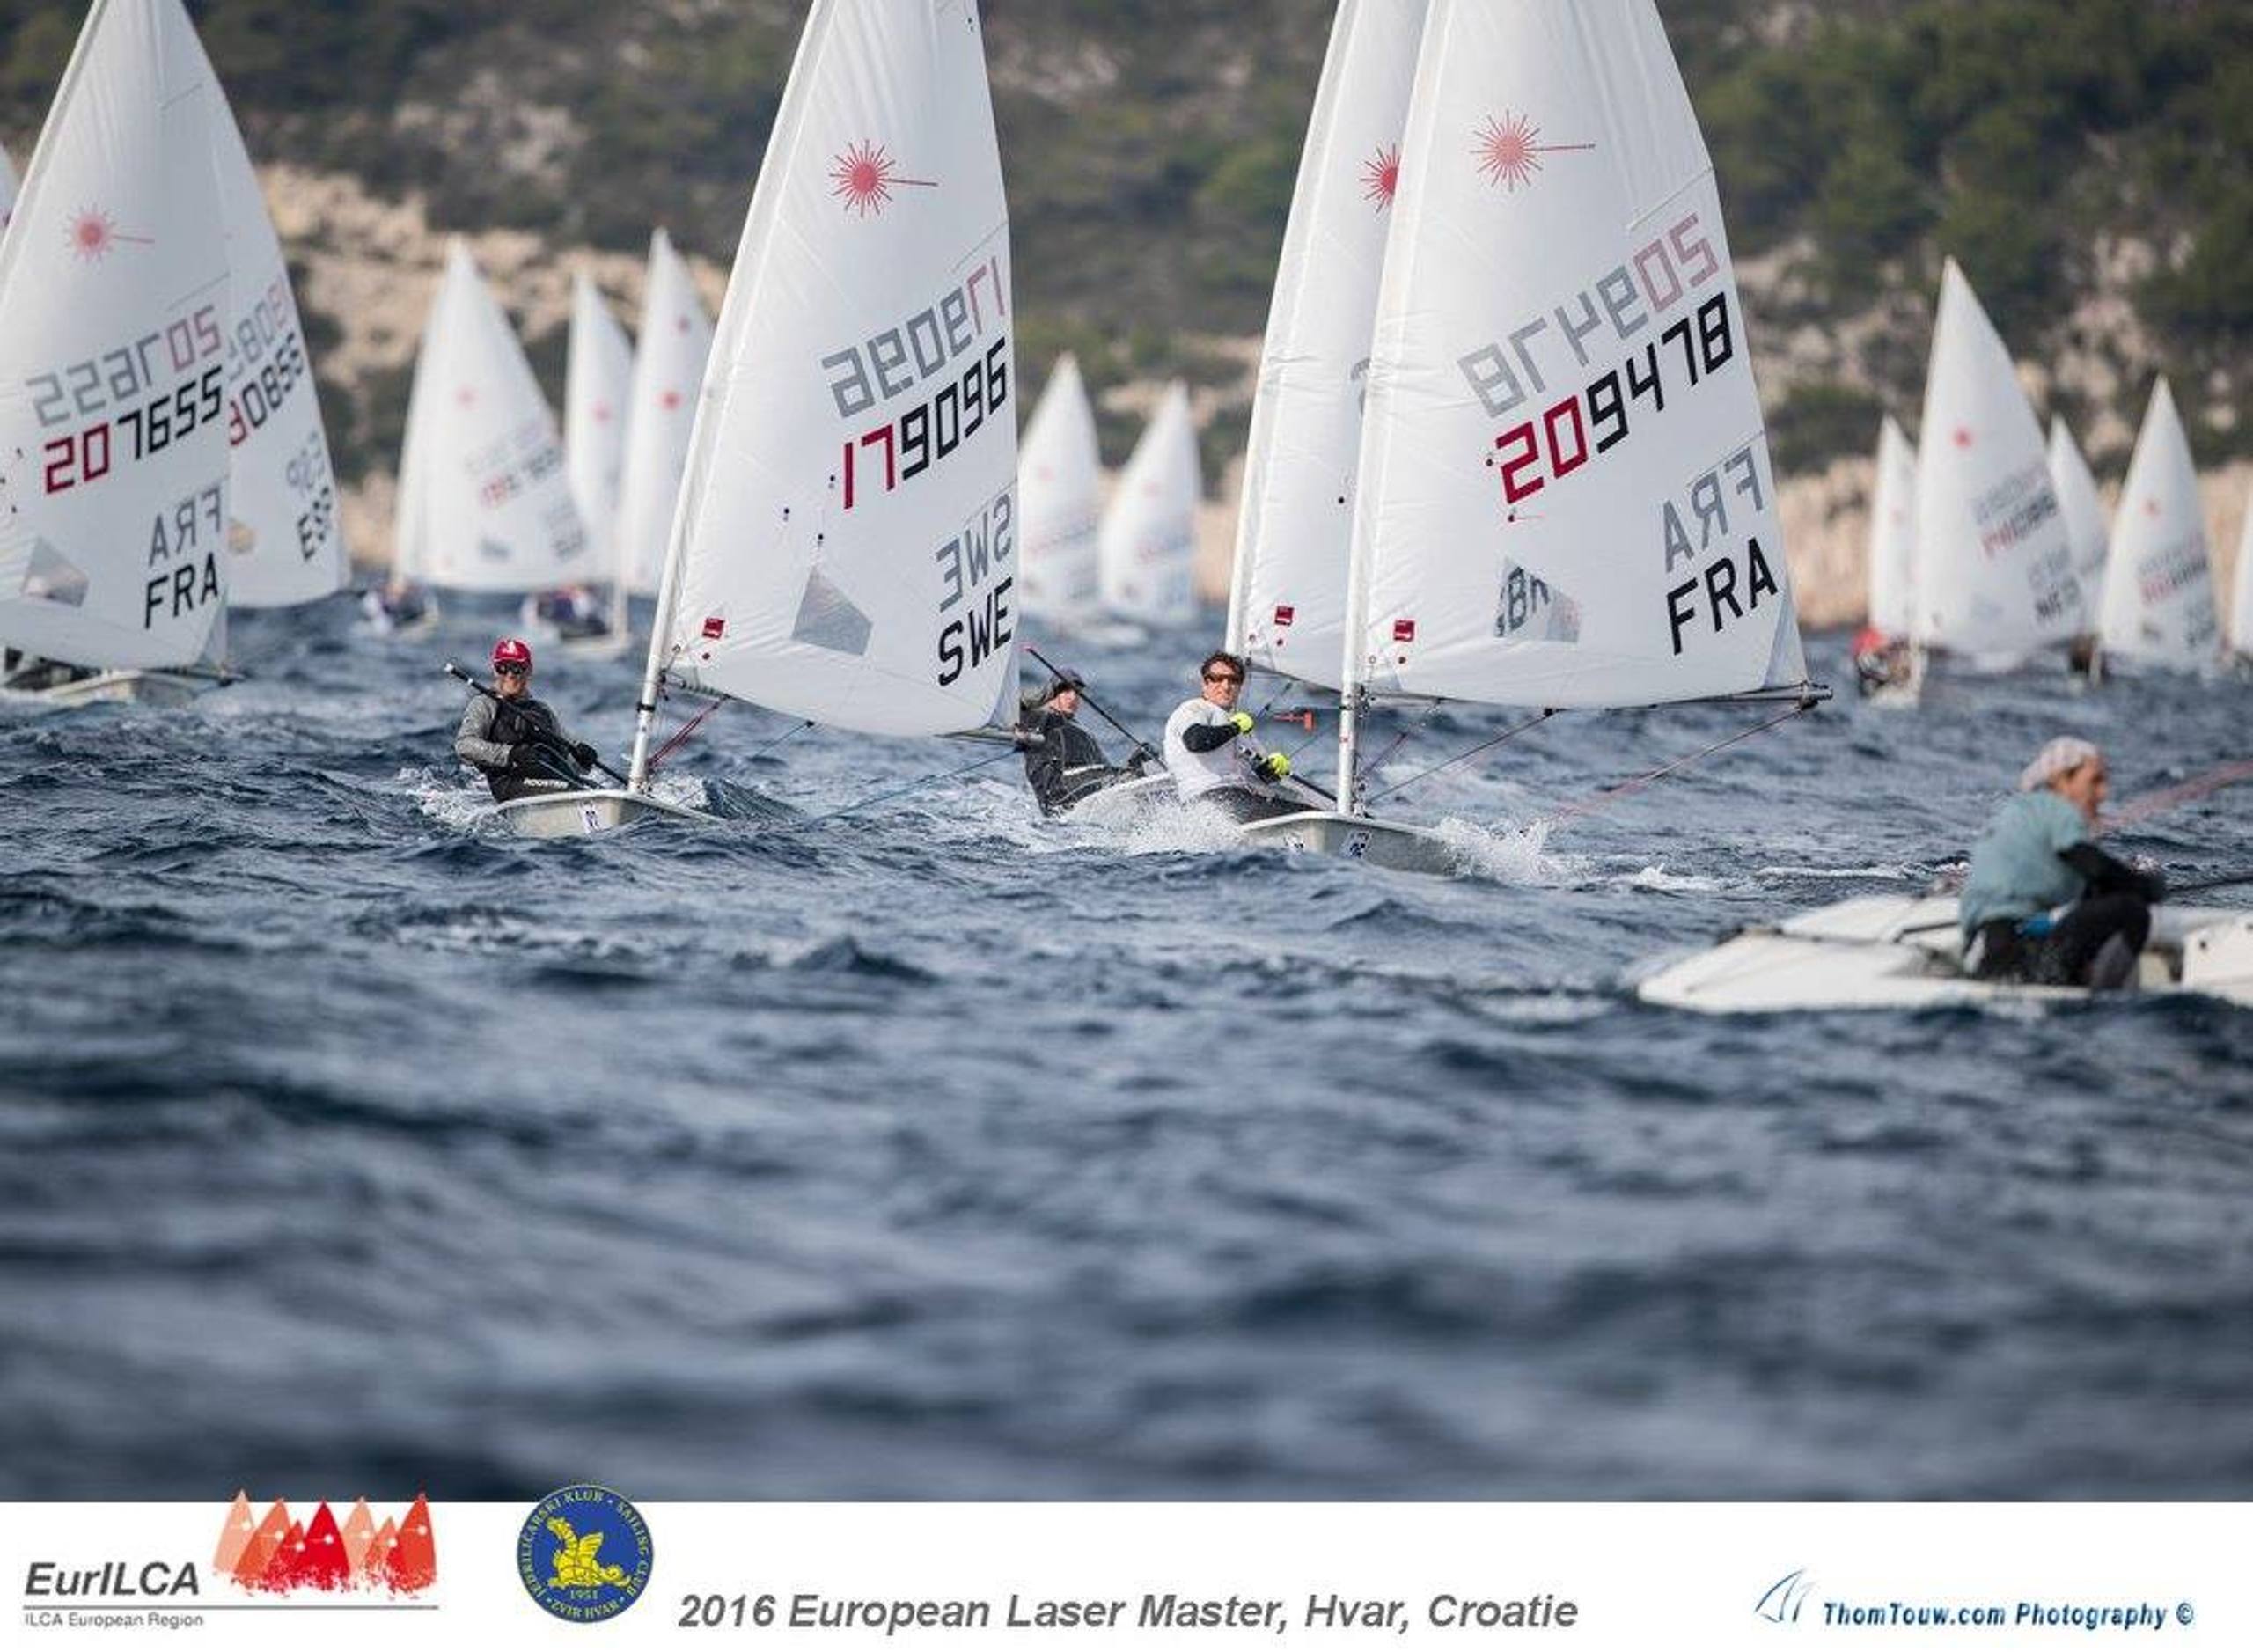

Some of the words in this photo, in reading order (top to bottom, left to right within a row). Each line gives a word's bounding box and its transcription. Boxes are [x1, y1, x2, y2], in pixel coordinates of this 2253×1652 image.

[44, 365, 224, 494] 207655
[843, 336, 1007, 510] 179096
[1495, 291, 1734, 504] 209478
[144, 552, 219, 629] FRA
[937, 576, 1014, 687] SWE
[1666, 537, 1778, 657] FRA
